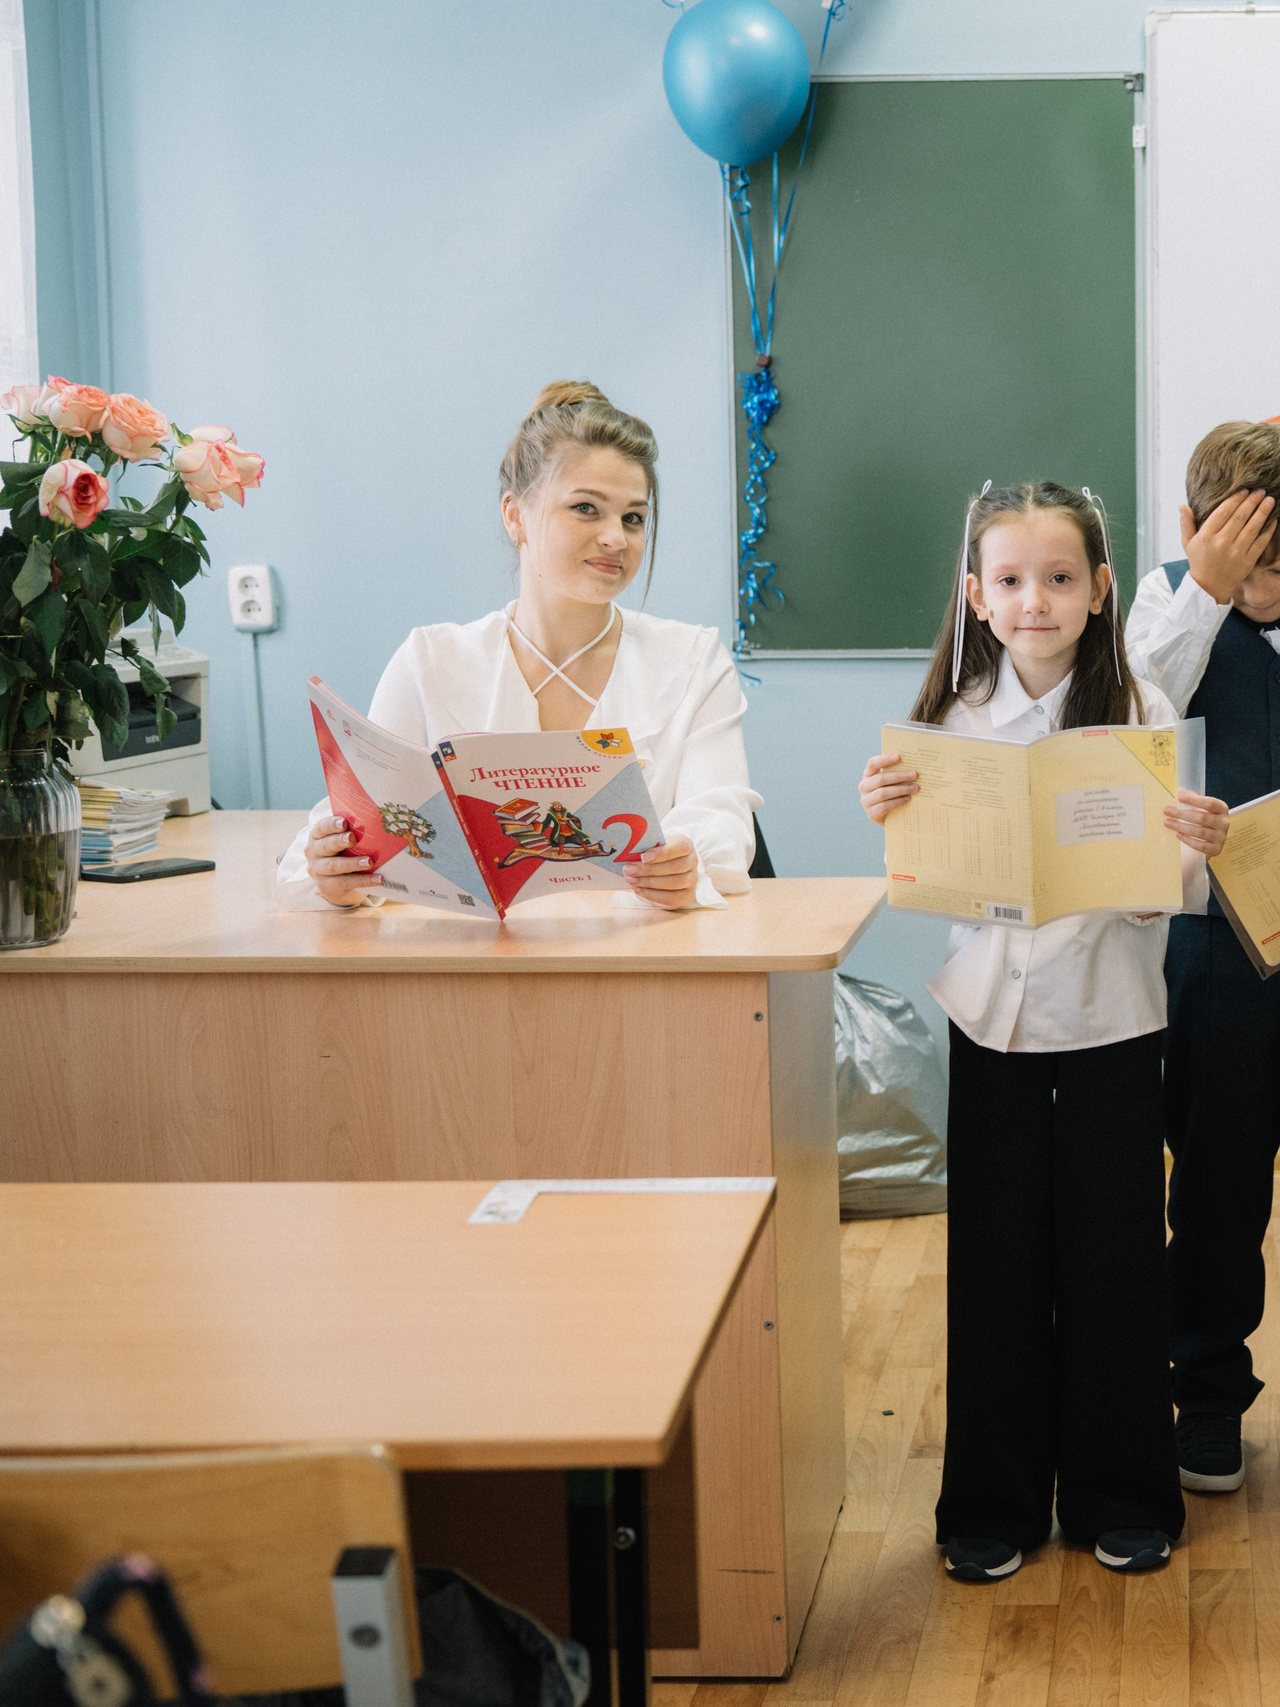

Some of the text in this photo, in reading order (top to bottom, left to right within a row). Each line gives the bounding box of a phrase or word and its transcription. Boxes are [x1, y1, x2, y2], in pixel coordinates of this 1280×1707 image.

[469, 764, 602, 783] Литературное
[493, 776, 587, 791] ЧТЕНИЕ
[601, 813, 660, 863] 2
[549, 876, 584, 884] Часть
